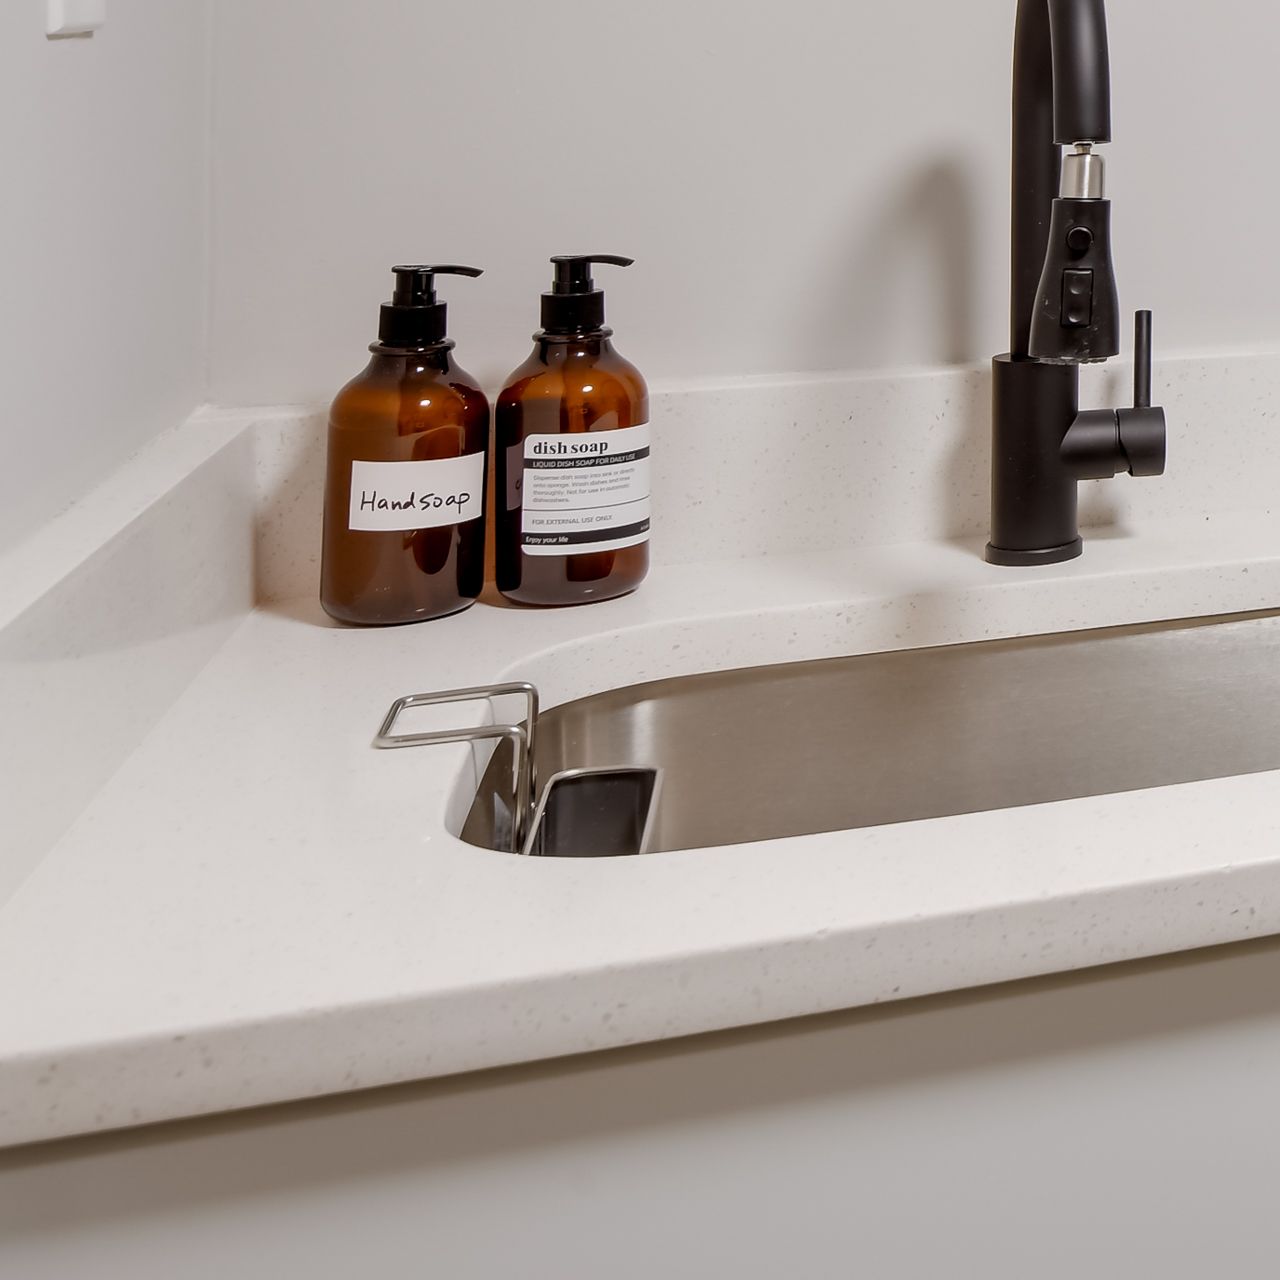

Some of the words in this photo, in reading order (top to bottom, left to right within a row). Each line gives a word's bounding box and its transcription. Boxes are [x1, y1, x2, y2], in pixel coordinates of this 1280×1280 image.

[533, 442, 567, 454] dish
[570, 441, 608, 454] soap
[575, 458, 595, 467] SOAP
[596, 457, 609, 465] FOR
[609, 455, 624, 463] DAILY
[525, 536, 541, 544] Enjoy
[542, 536, 557, 544] your
